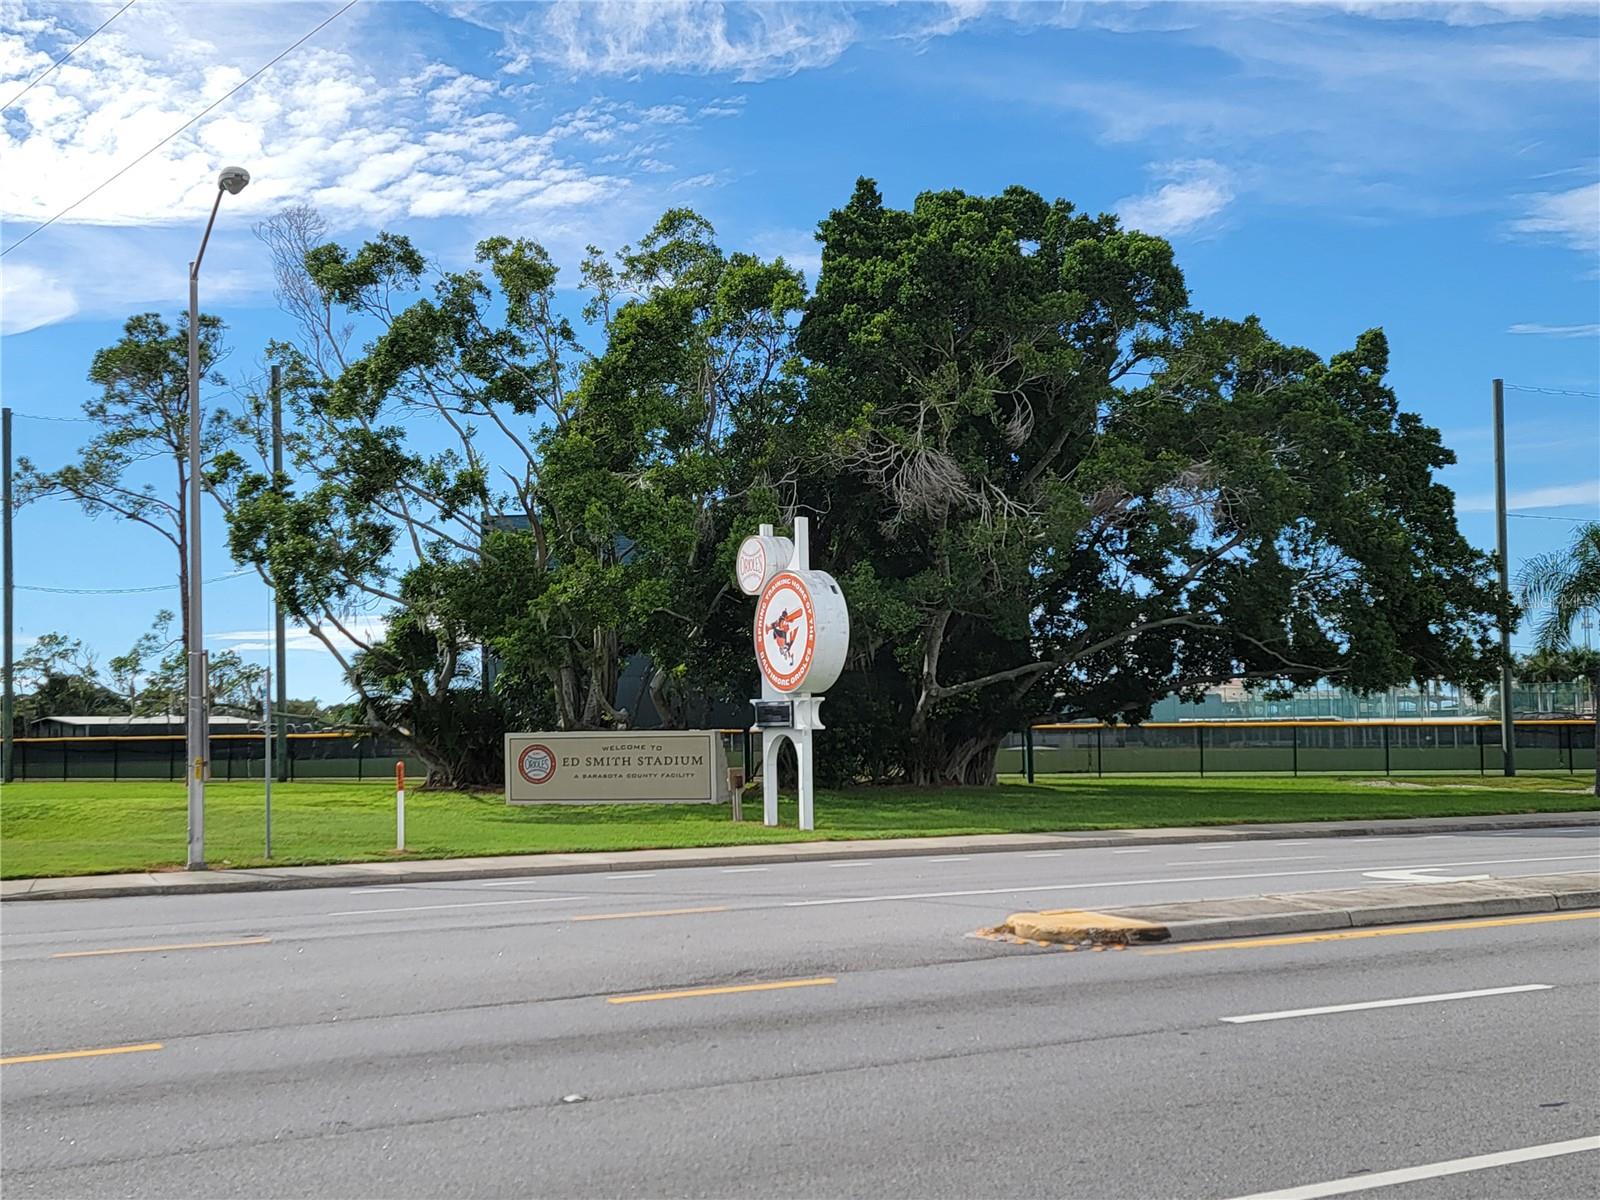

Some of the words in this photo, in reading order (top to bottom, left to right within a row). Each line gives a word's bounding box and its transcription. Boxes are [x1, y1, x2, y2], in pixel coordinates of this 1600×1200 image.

[757, 602, 767, 642] SPRING
[765, 578, 792, 601] TRAINING
[791, 580, 808, 601] HOME
[806, 601, 812, 615] OF
[760, 651, 790, 686] BALTIMORE
[790, 648, 812, 684] ORIOLES
[601, 744, 647, 752] WELCOME
[650, 744, 663, 752] TO
[525, 758, 549, 771] ORIOLES
[562, 757, 580, 767] ED
[585, 756, 631, 767] SMITH
[637, 755, 704, 766] STADIUM
